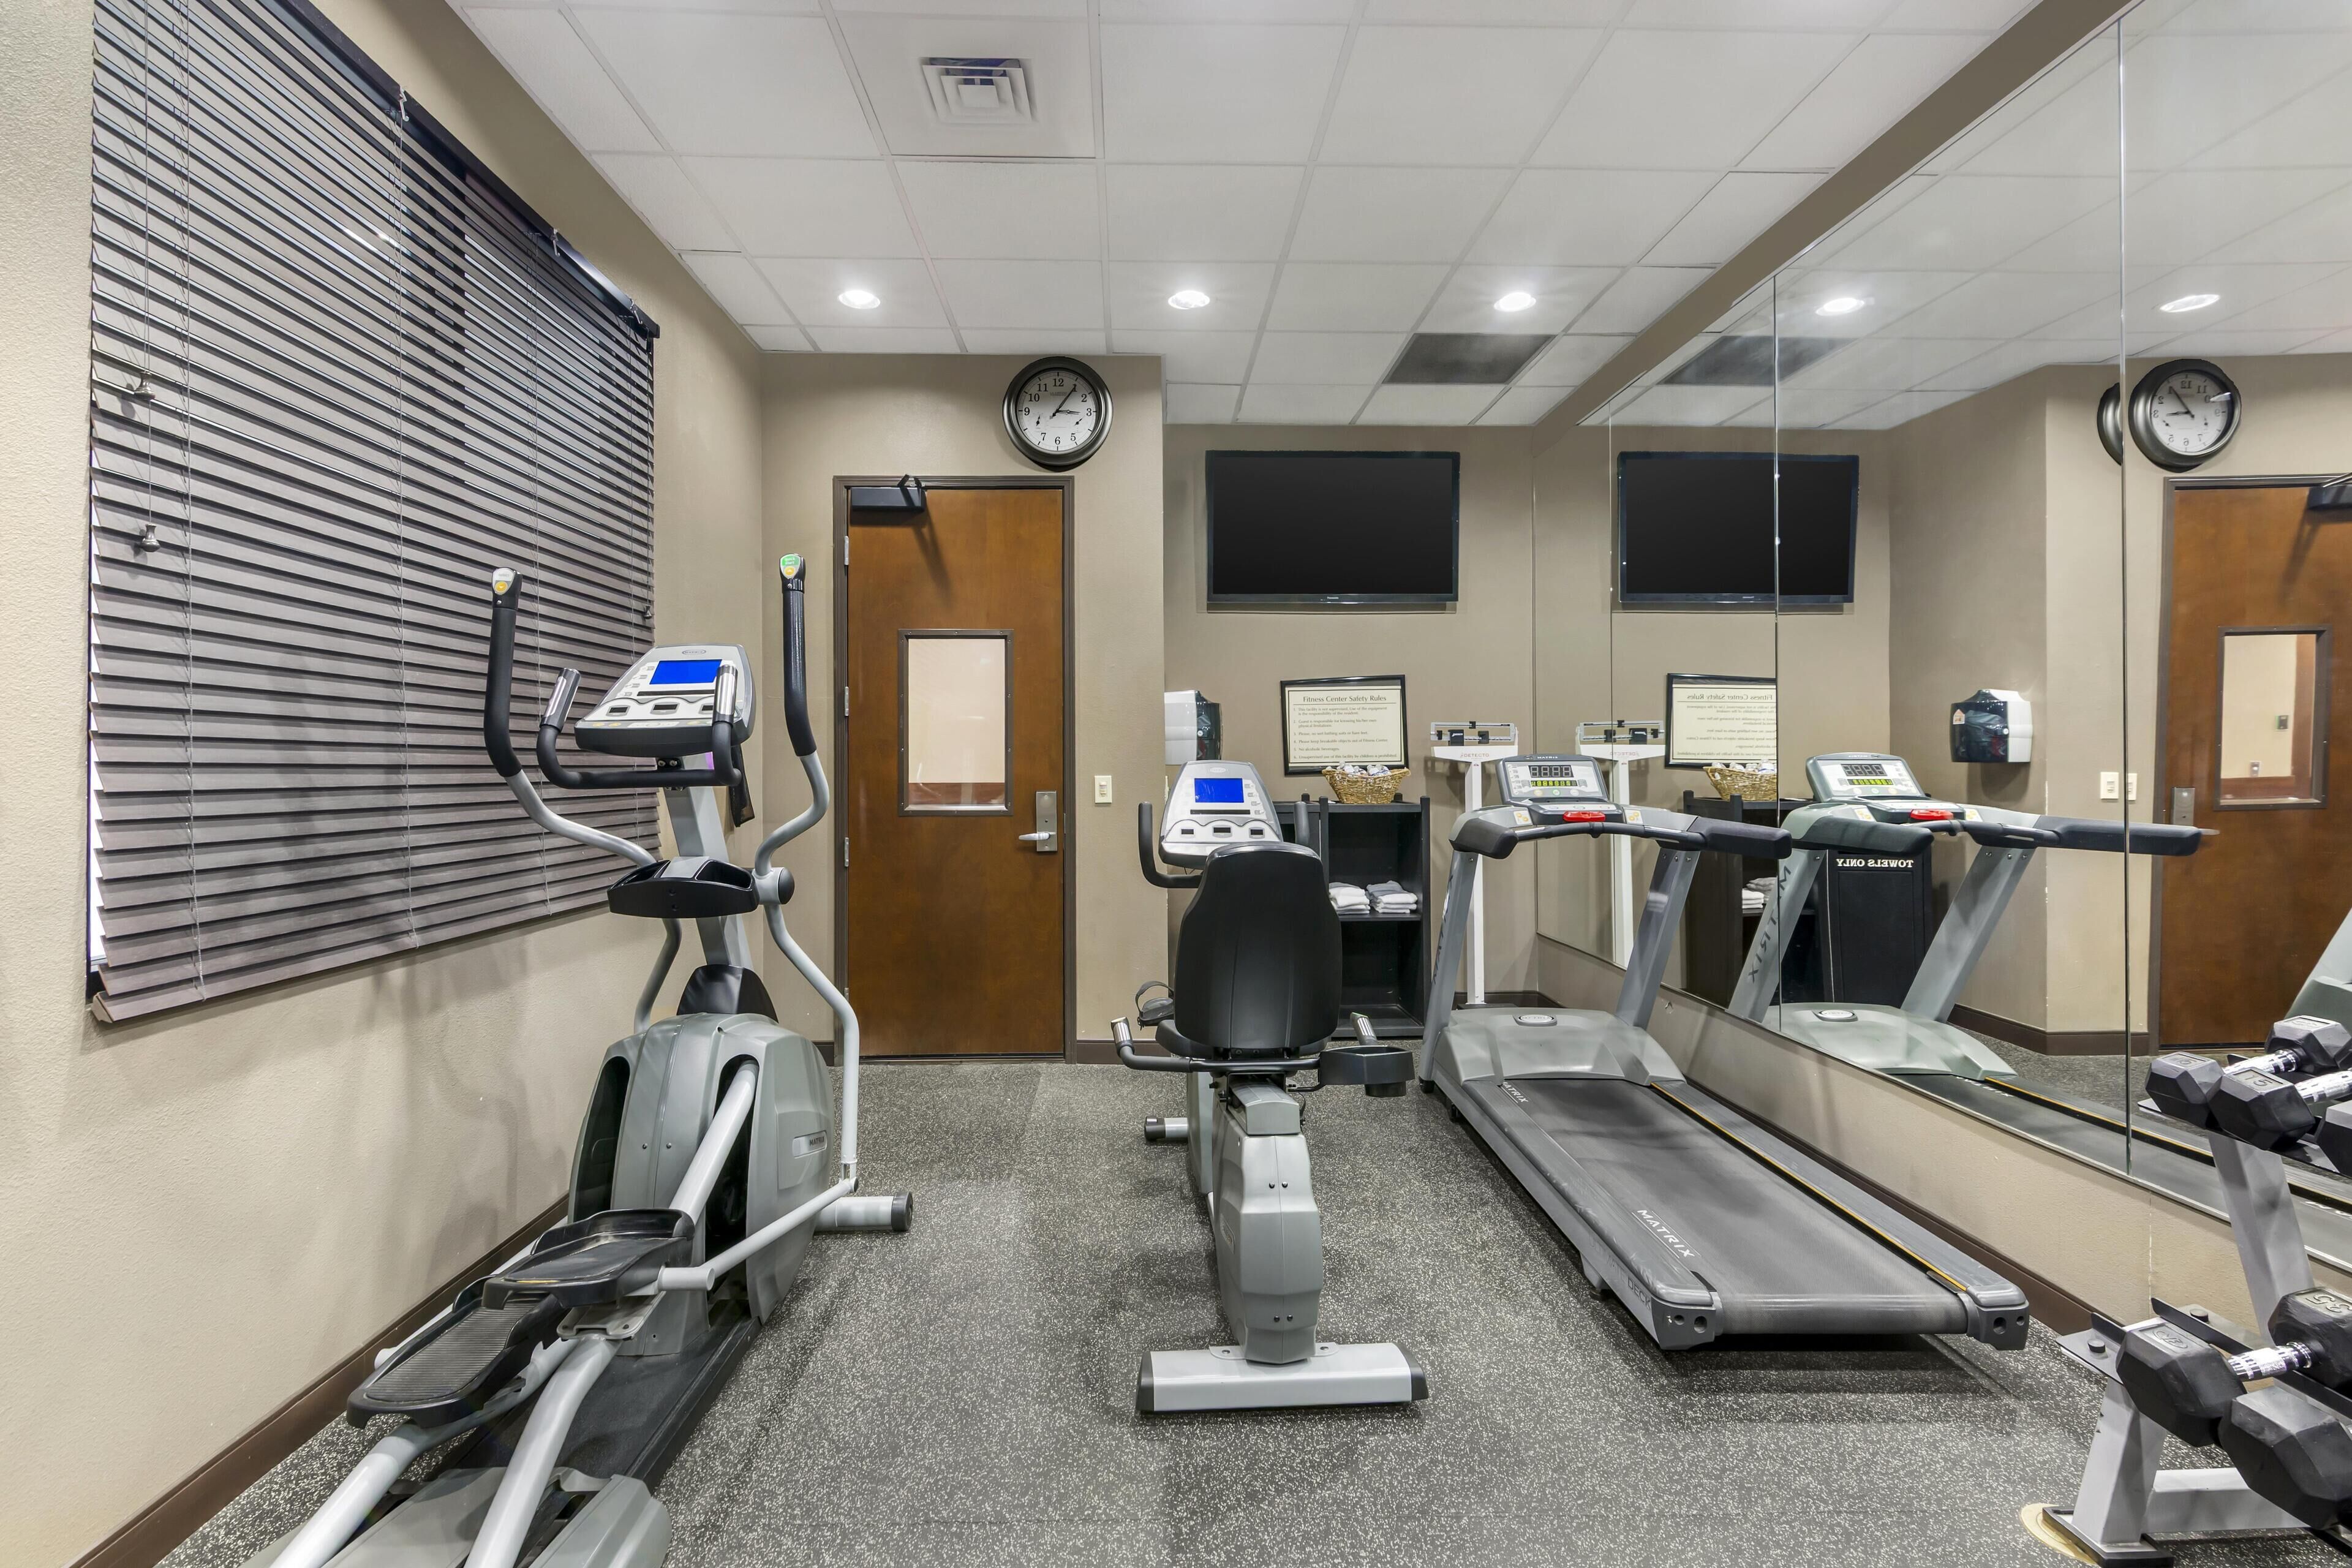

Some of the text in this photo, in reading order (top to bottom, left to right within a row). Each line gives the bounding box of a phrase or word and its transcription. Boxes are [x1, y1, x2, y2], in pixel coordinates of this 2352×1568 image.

[1037, 383, 1048, 392] 11
[1053, 379, 1064, 387] 12
[1028, 393, 1040, 402] 10
[1081, 394, 1087, 402] 2
[1023, 407, 1030, 416] 9
[1086, 408, 1092, 417] 3
[1041, 432, 1047, 441] 7
[1055, 437, 1061, 445] 6
[1070, 433, 1076, 442] 5
[2244, 1074, 2274, 1087] 15
[1637, 1210, 1695, 1257] MATRIX
[1627, 1276, 1651, 1310] DECK
